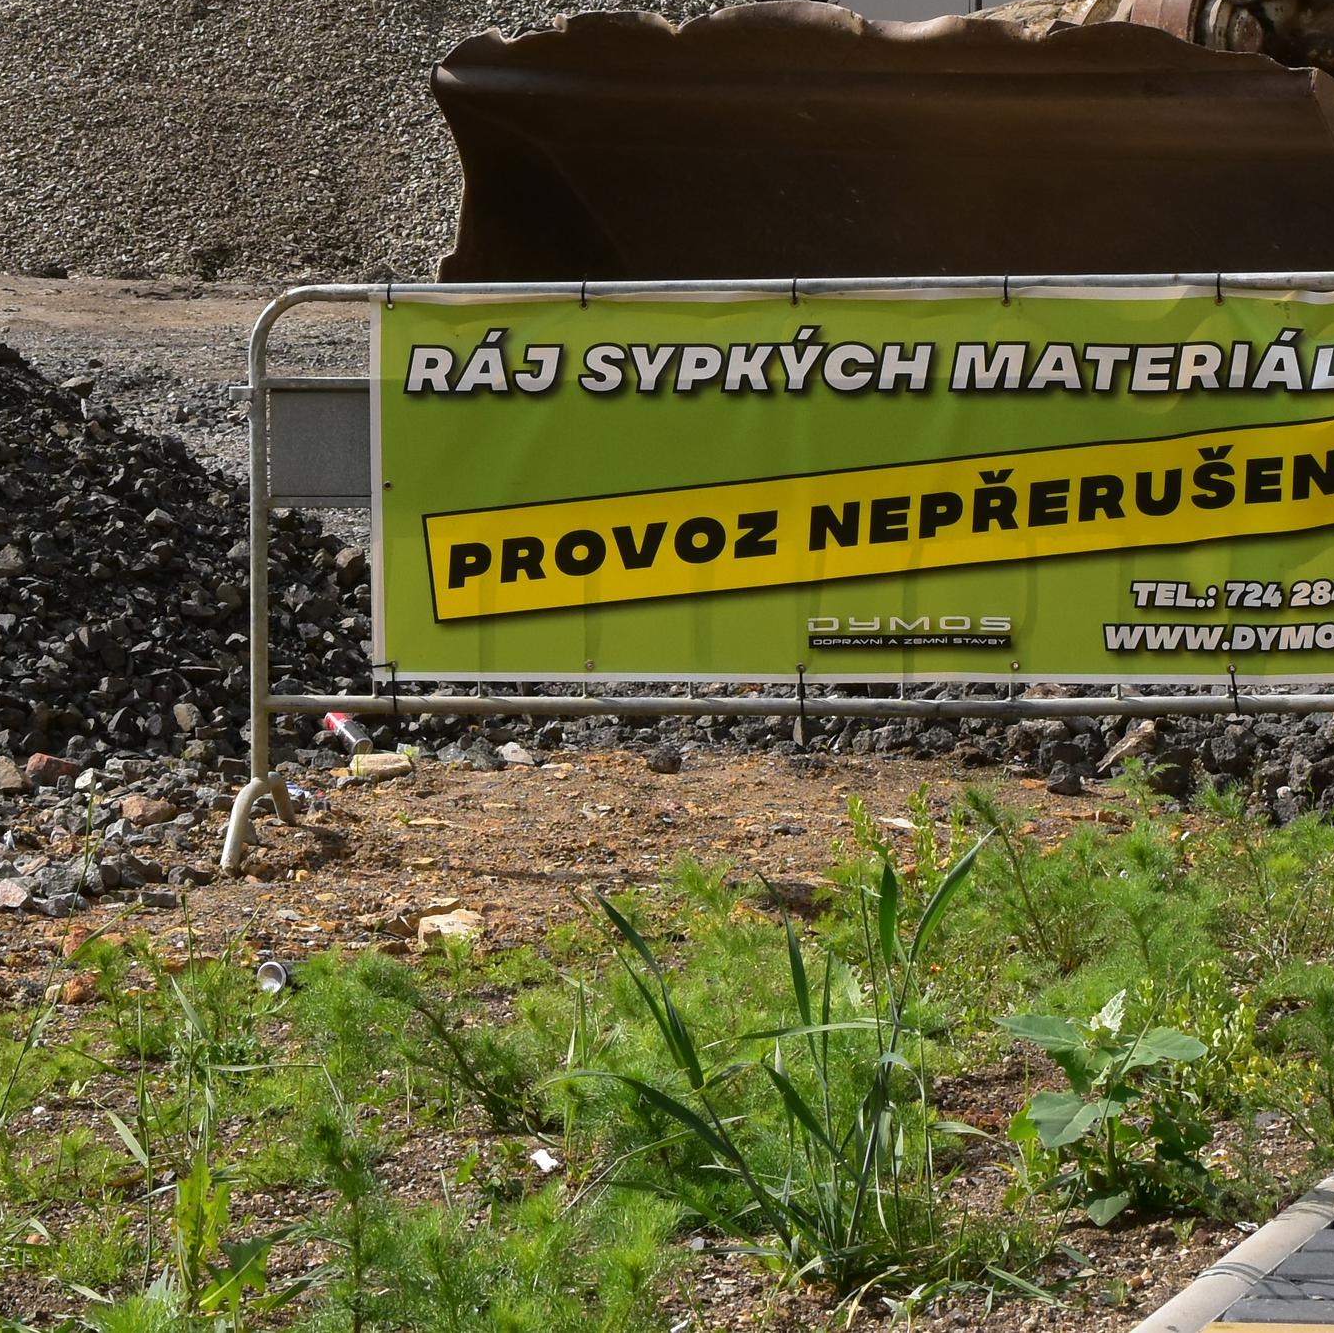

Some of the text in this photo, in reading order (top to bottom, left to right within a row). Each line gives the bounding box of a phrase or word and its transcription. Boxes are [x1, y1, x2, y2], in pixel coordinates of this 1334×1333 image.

[404, 327, 564, 395] RÁJ
[578, 325, 937, 395] SYPKÝCH
[447, 509, 779, 589] PROVOZ
[1130, 580, 1219, 608] TEL.:
[1224, 580, 1283, 608] 724
[807, 616, 1012, 632] DYMOS
[812, 637, 883, 646] DOPRAVNÍ
[903, 635, 948, 645] ZEMNÍ
[952, 637, 1007, 645] STAVBY
